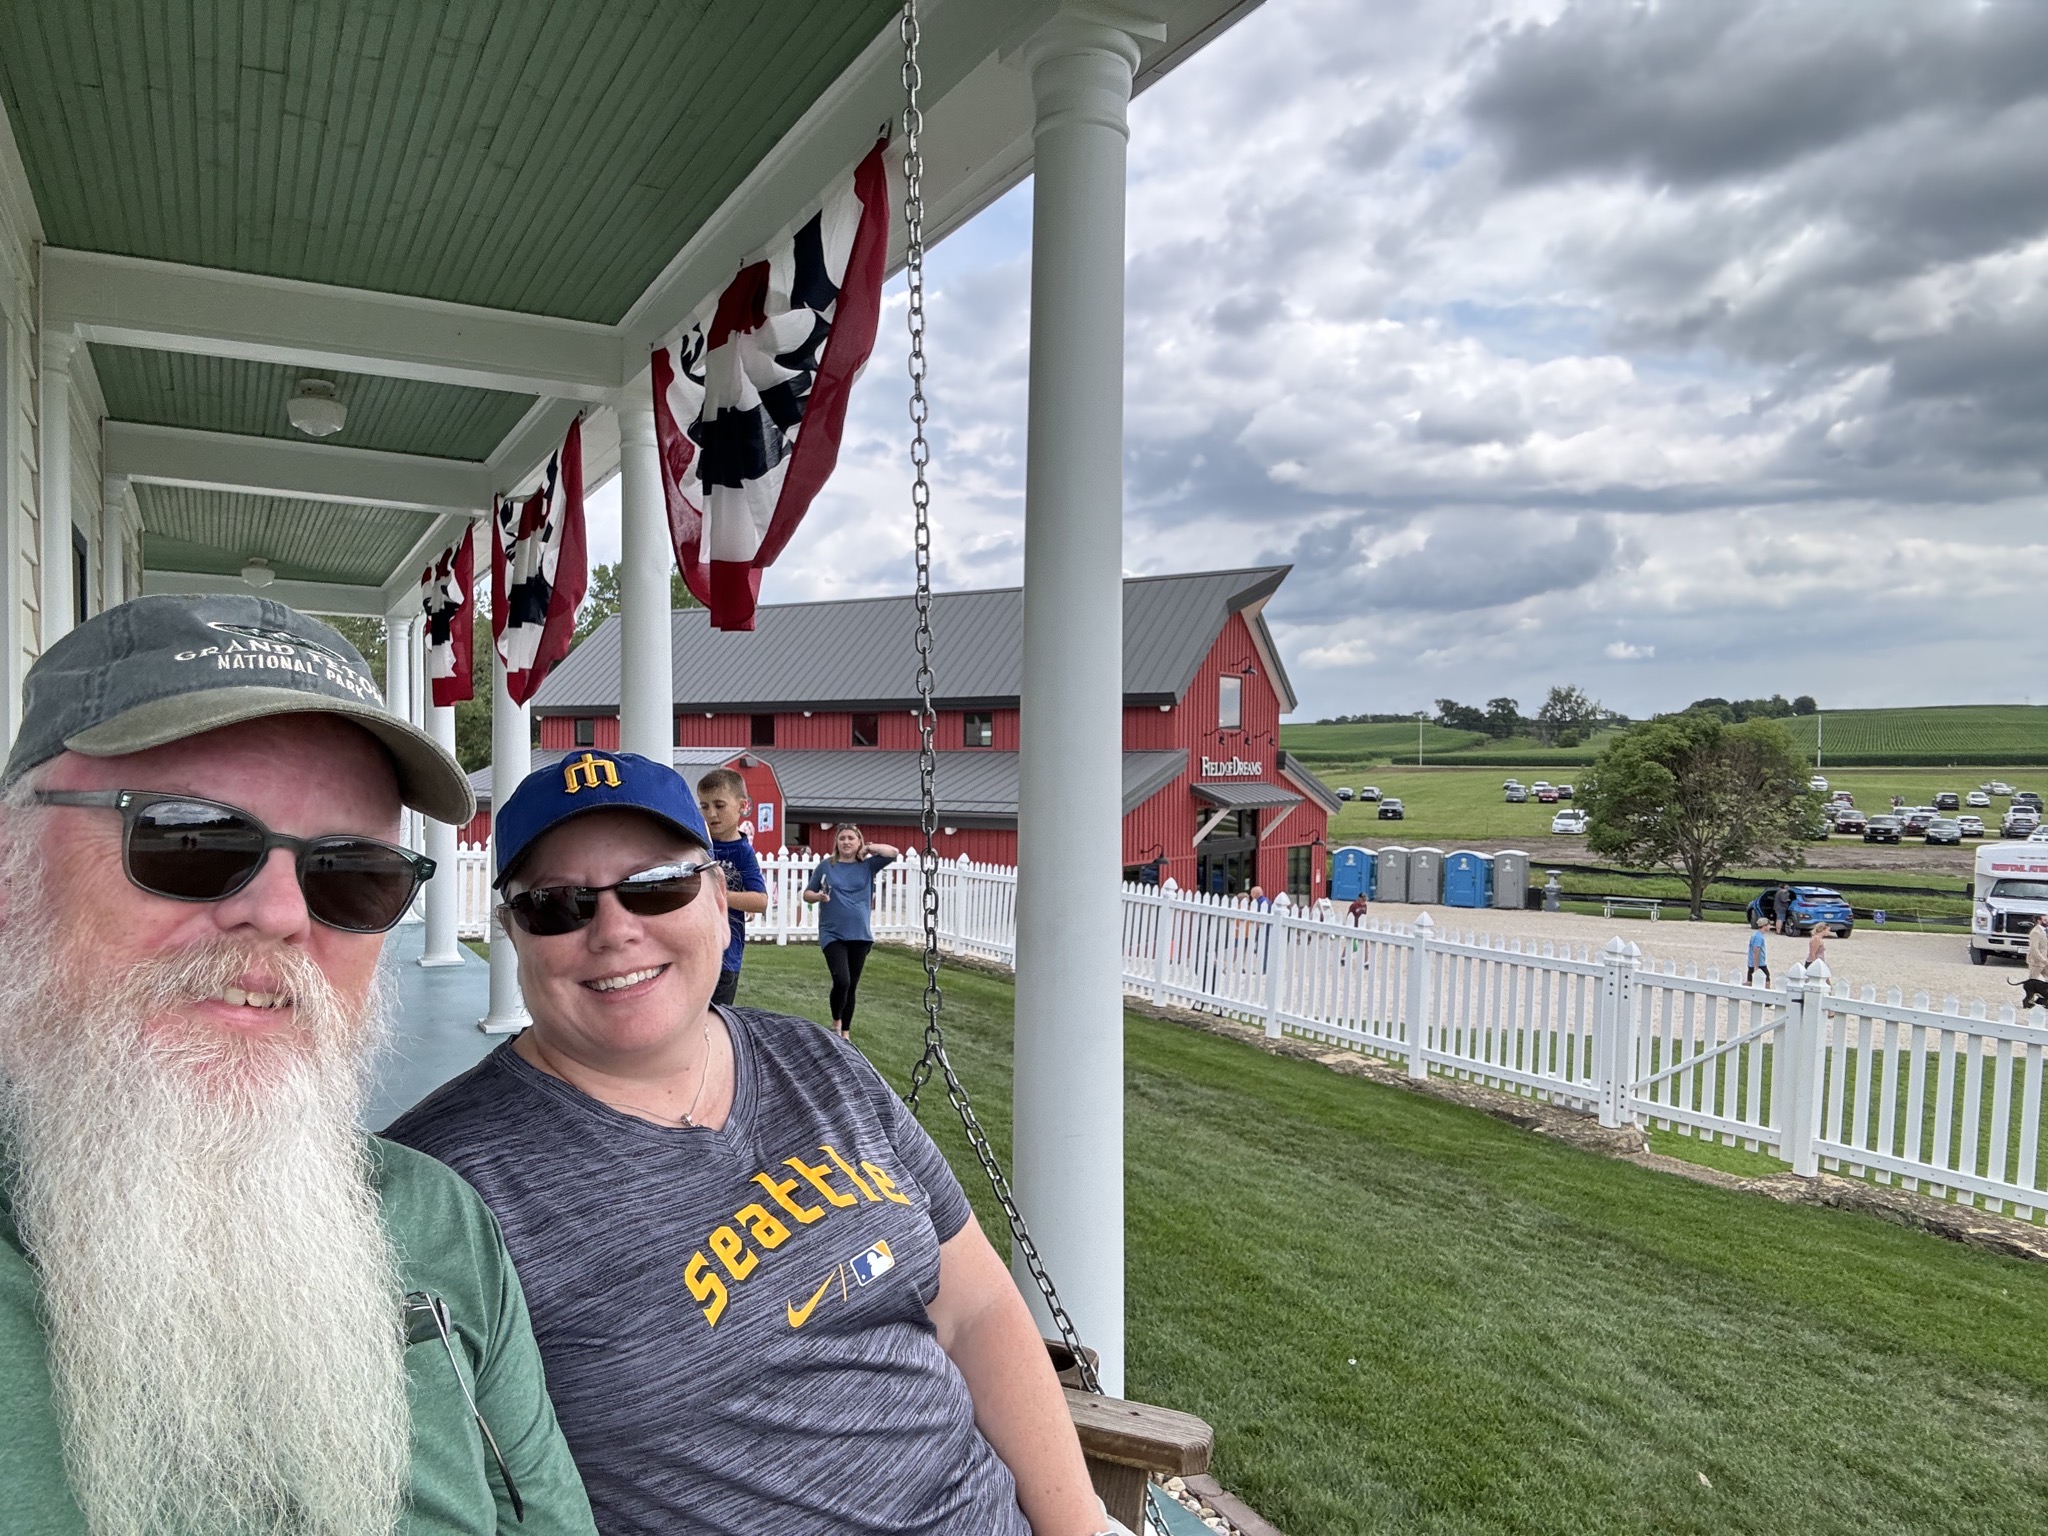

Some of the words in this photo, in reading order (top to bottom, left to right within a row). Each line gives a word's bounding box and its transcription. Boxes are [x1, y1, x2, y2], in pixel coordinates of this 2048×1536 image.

[174, 638, 295, 661] GRAND
[306, 651, 385, 708] TETON
[217, 653, 319, 677] NATIONAL
[325, 668, 366, 701] PARK
[684, 1145, 912, 1329] seattle
